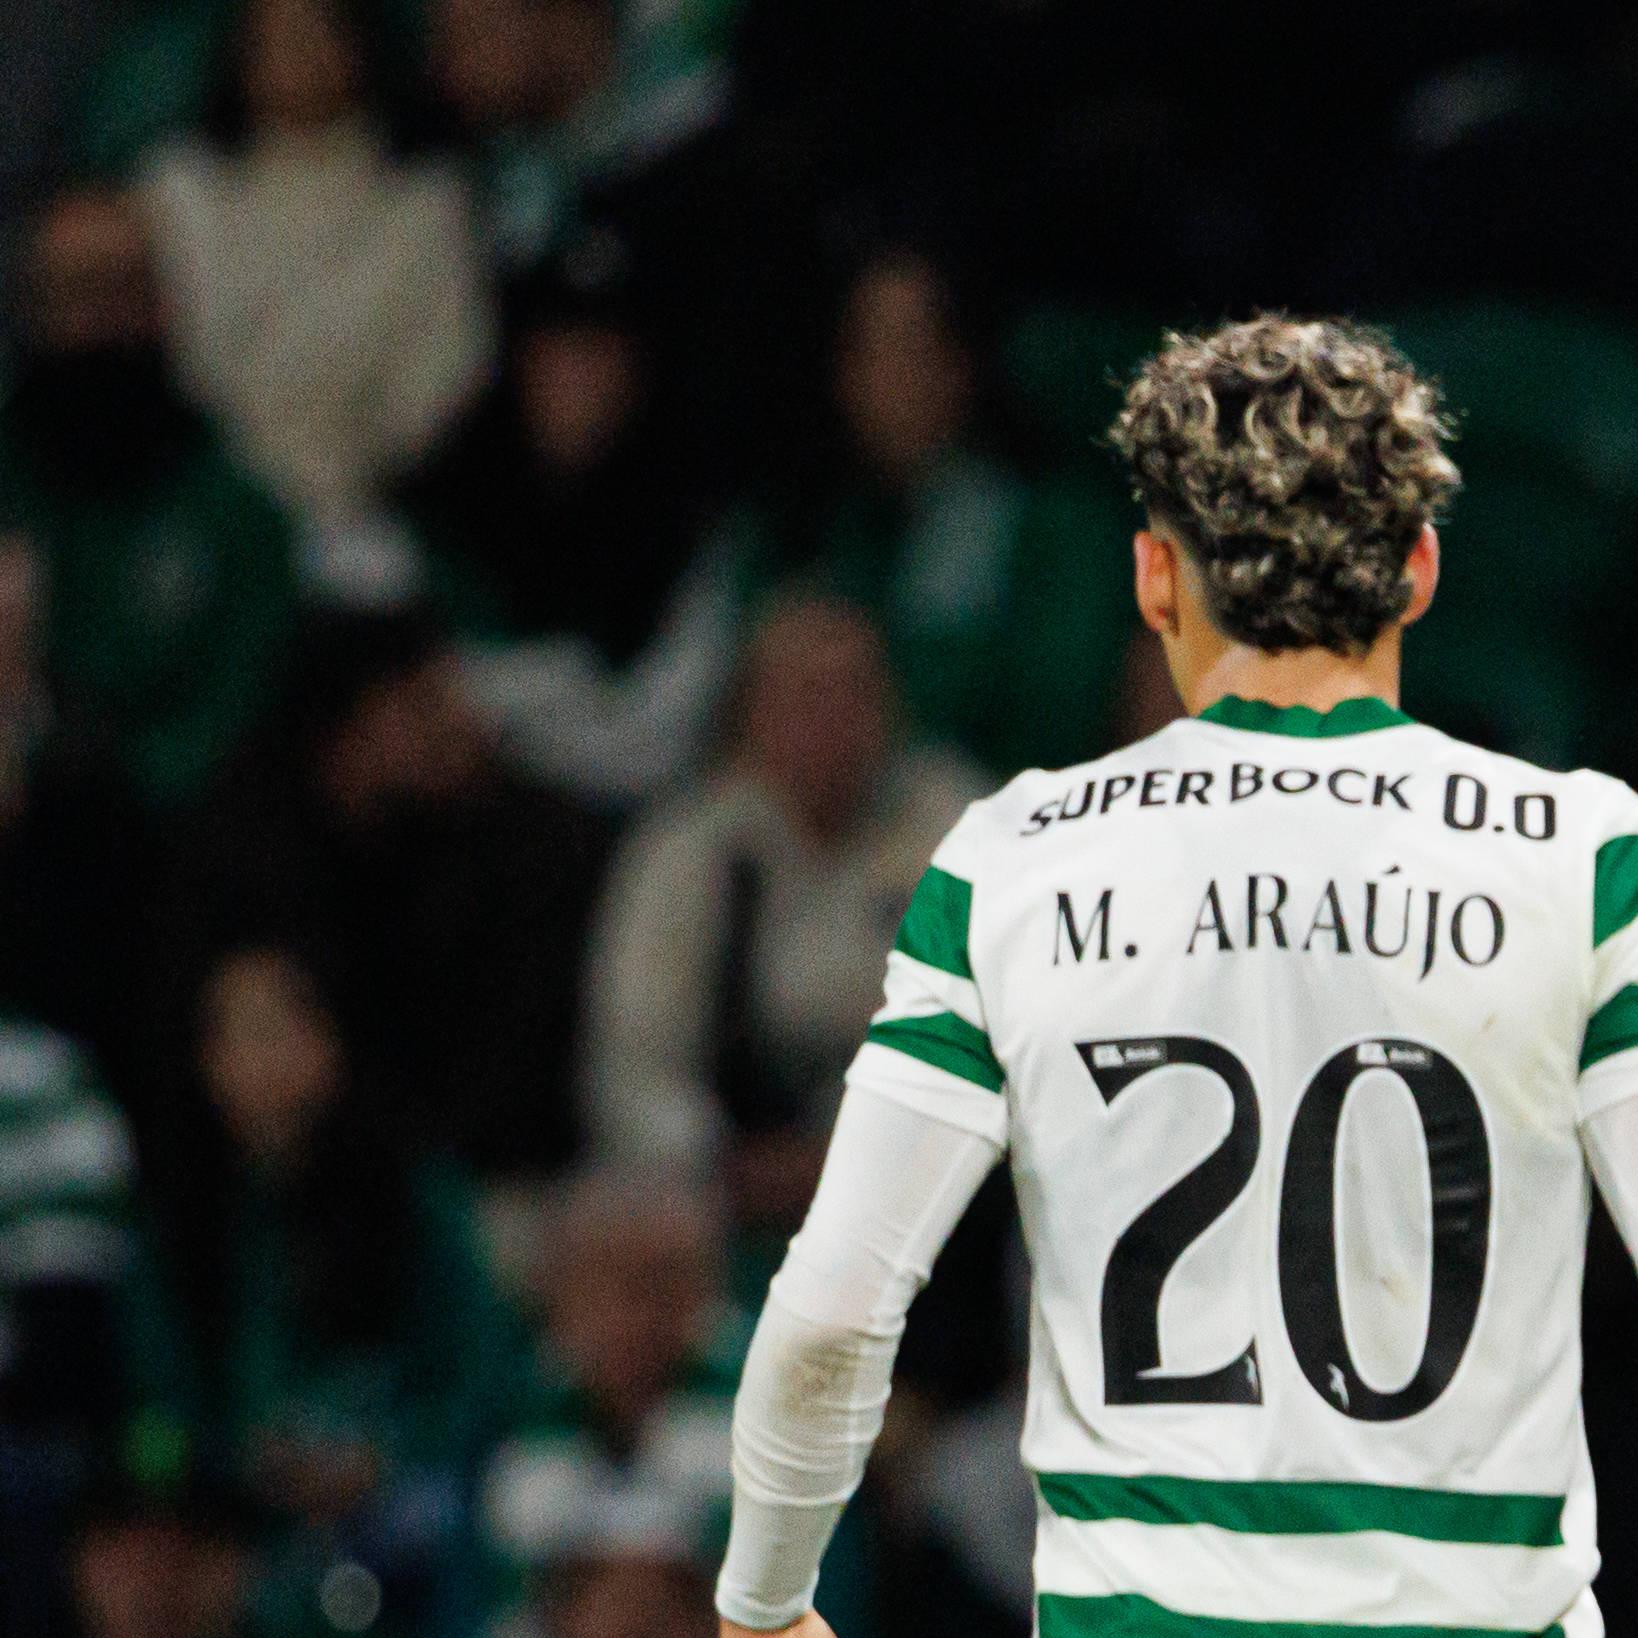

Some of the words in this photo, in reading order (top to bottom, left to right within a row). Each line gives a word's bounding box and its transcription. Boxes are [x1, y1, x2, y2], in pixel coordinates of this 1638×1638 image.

[1019, 768, 1214, 837] SUPER
[1230, 763, 1413, 811] BOCK
[1443, 772, 1557, 841] 0.0
[1053, 889, 1138, 966] M.
[1185, 864, 1505, 983] ARAÚJO
[1073, 1034, 1494, 1423] 20
